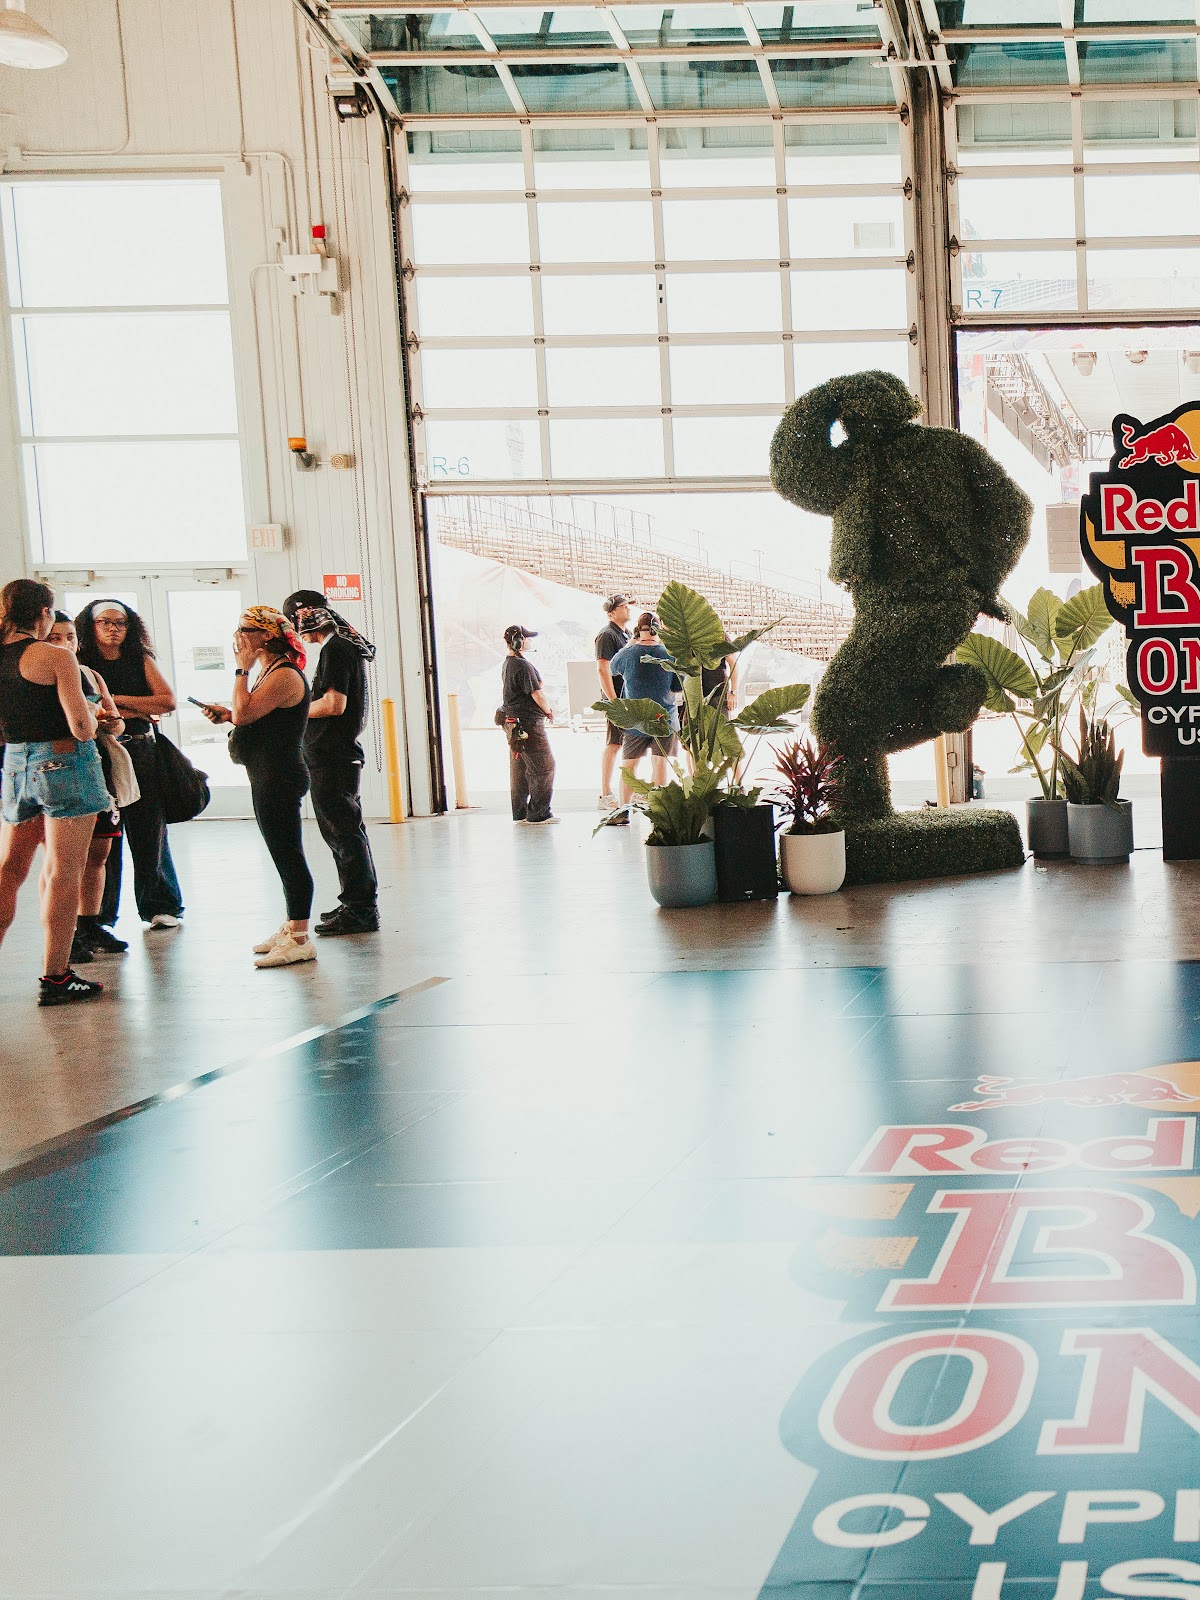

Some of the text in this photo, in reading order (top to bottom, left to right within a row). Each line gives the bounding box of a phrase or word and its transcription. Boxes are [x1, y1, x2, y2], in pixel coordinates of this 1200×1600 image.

[967, 289, 1003, 308] R-7
[433, 456, 470, 475] R-6
[1100, 479, 1200, 534] Red
[252, 528, 276, 547] EXIT
[336, 575, 347, 587] NO
[325, 587, 360, 598] SMOKING
[845, 1115, 1197, 1178] Red
